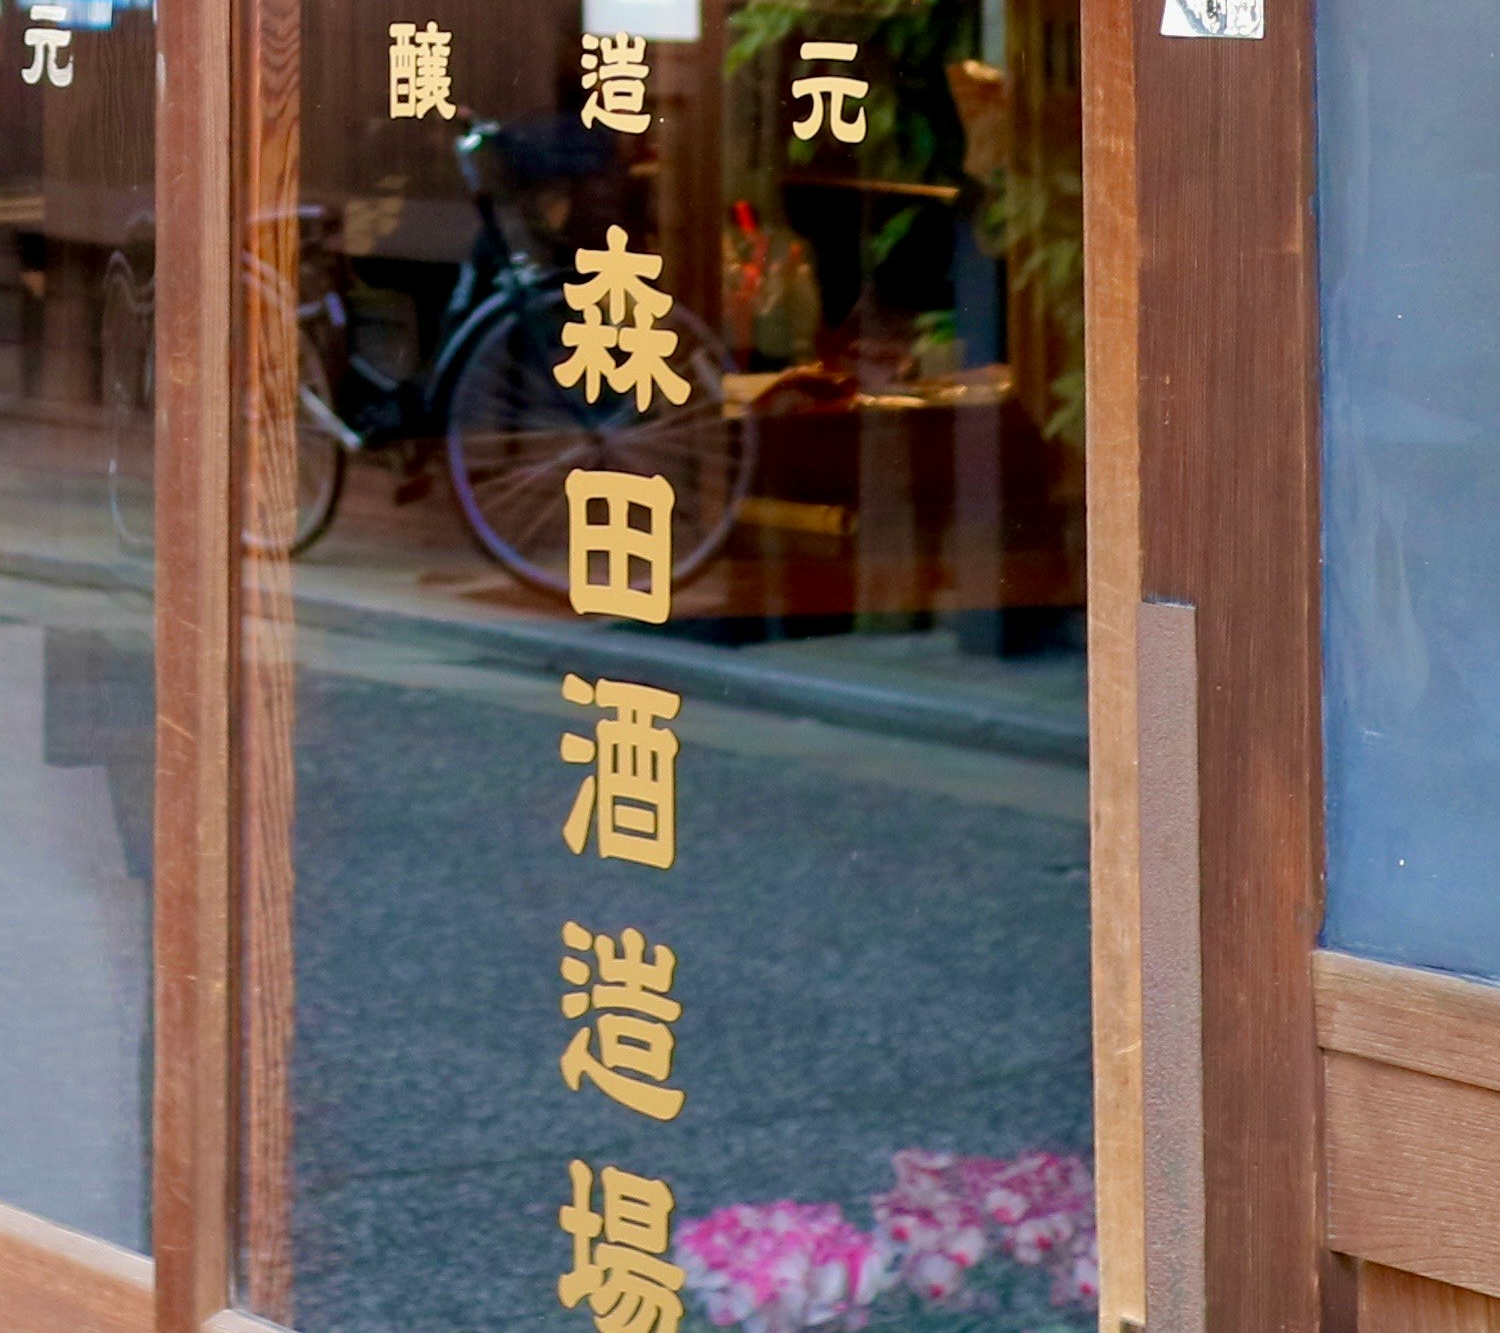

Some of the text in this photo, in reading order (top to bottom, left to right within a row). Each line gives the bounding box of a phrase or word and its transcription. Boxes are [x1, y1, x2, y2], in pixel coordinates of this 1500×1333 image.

[387, 19, 870, 146] 醸造元
[551, 223, 693, 1333] 森田酒造場
